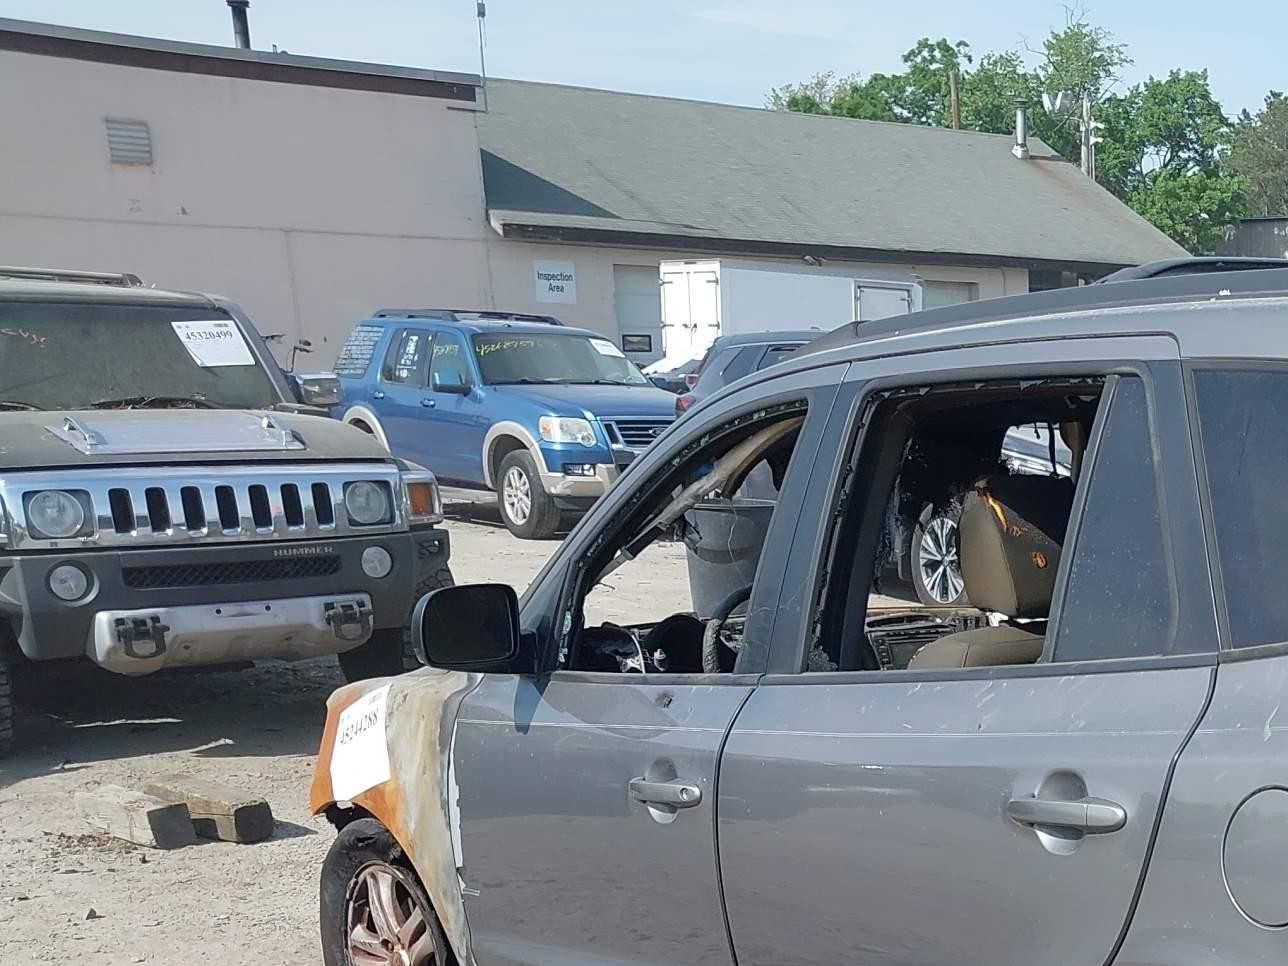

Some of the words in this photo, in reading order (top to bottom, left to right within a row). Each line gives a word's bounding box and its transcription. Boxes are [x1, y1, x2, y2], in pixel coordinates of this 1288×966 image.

[536, 269, 574, 282] Inspection
[548, 283, 565, 293] Area
[184, 330, 233, 341] 45320499
[272, 545, 335, 557] HUMMER
[340, 708, 379, 744] 45244288
